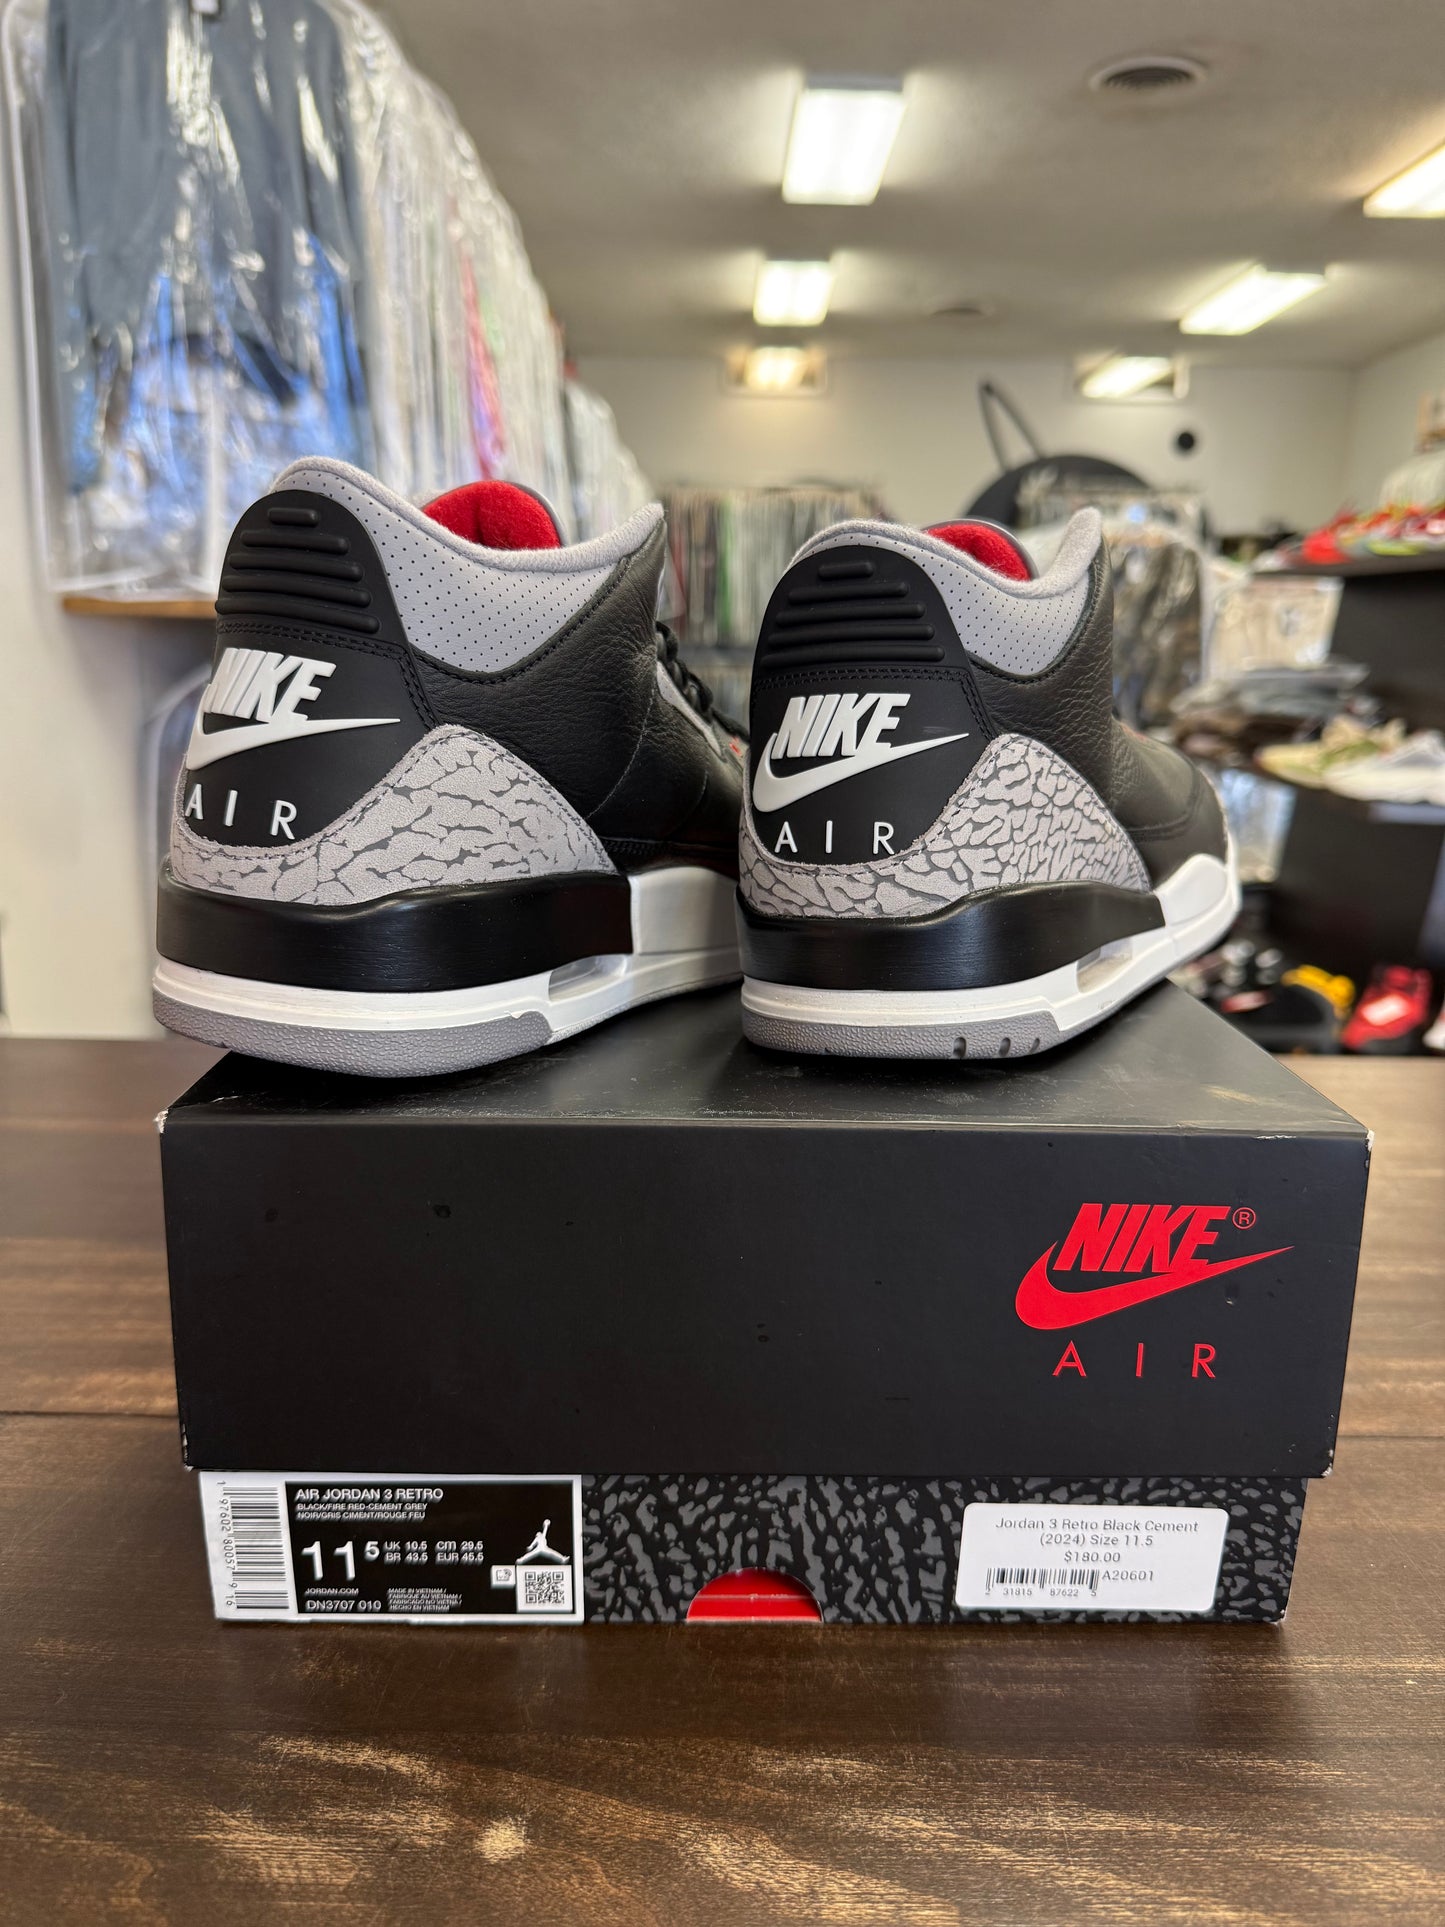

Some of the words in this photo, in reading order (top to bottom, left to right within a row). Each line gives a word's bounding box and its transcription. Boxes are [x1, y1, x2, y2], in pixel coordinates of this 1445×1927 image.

[203, 648, 336, 723] NIKE
[771, 693, 911, 759] NIKE
[185, 784, 297, 839] AIR
[774, 820, 895, 855] AIR
[1053, 1203, 1231, 1273] NIKE
[1052, 1340, 1216, 1378] AIR
[296, 1488, 320, 1500] AIR
[322, 1488, 380, 1501] JORDAN
[383, 1489, 393, 1501] 3
[396, 1488, 443, 1501] RETRO
[404, 1503, 428, 1511] GREY
[409, 1511, 426, 1519] FEU
[996, 1517, 1045, 1530] Jordan
[1049, 1518, 1058, 1530] 3
[1062, 1518, 1098, 1531] Retro
[1103, 1518, 1140, 1531] Black
[1144, 1519, 1199, 1533] Cement
[385, 1540, 401, 1550] UK
[405, 1540, 428, 1550] 10.5
[460, 1540, 484, 1550] 29.5
[1040, 1533, 1086, 1547] (2024)
[1090, 1533, 1119, 1547] Size
[1124, 1534, 1154, 1547] 11.5
[385, 1552, 401, 1562] BR
[405, 1552, 428, 1562] 43.5
[437, 1552, 459, 1562] EUR
[461, 1552, 484, 1562] 45.5
[1064, 1549, 1121, 1564] $180.00
[1102, 1569, 1154, 1582] A20601
[305, 1587, 359, 1595] JORDAN.COM
[306, 1600, 355, 1611] DN3707
[358, 1600, 382, 1611] 010
